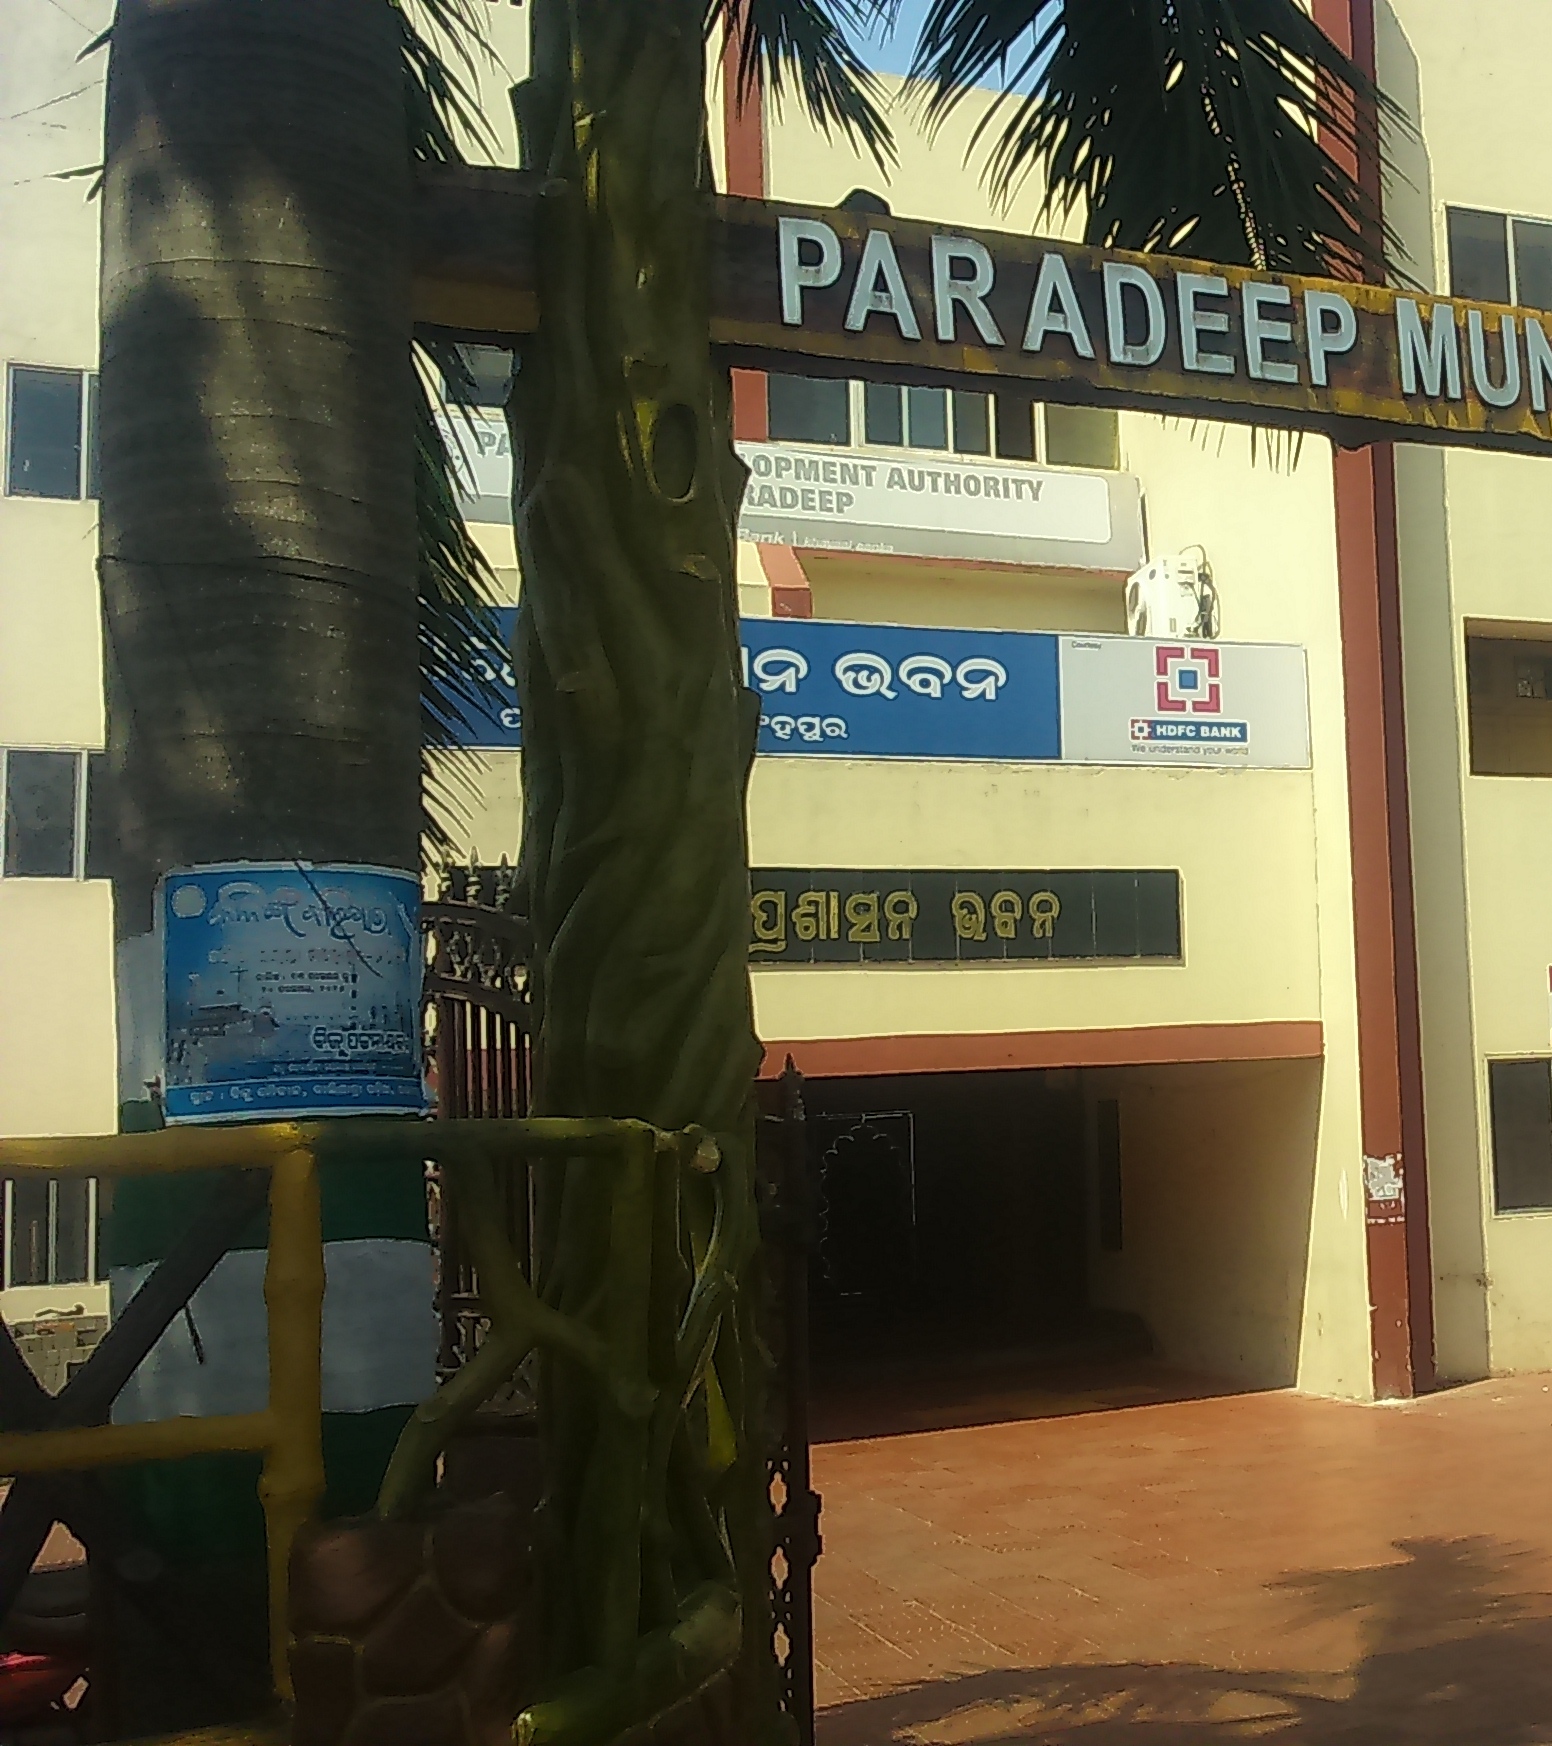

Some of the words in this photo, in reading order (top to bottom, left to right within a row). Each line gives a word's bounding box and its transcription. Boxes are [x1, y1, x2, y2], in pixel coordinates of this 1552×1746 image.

[777, 215, 1358, 386] PARADEEP
[886, 466, 1044, 502] AUTHORITY
[834, 652, 1007, 700] ଭବନ
[1156, 724, 1197, 738] HDFC
[1200, 725, 1242, 739] BANK
[950, 891, 1061, 942] ଭବନ
